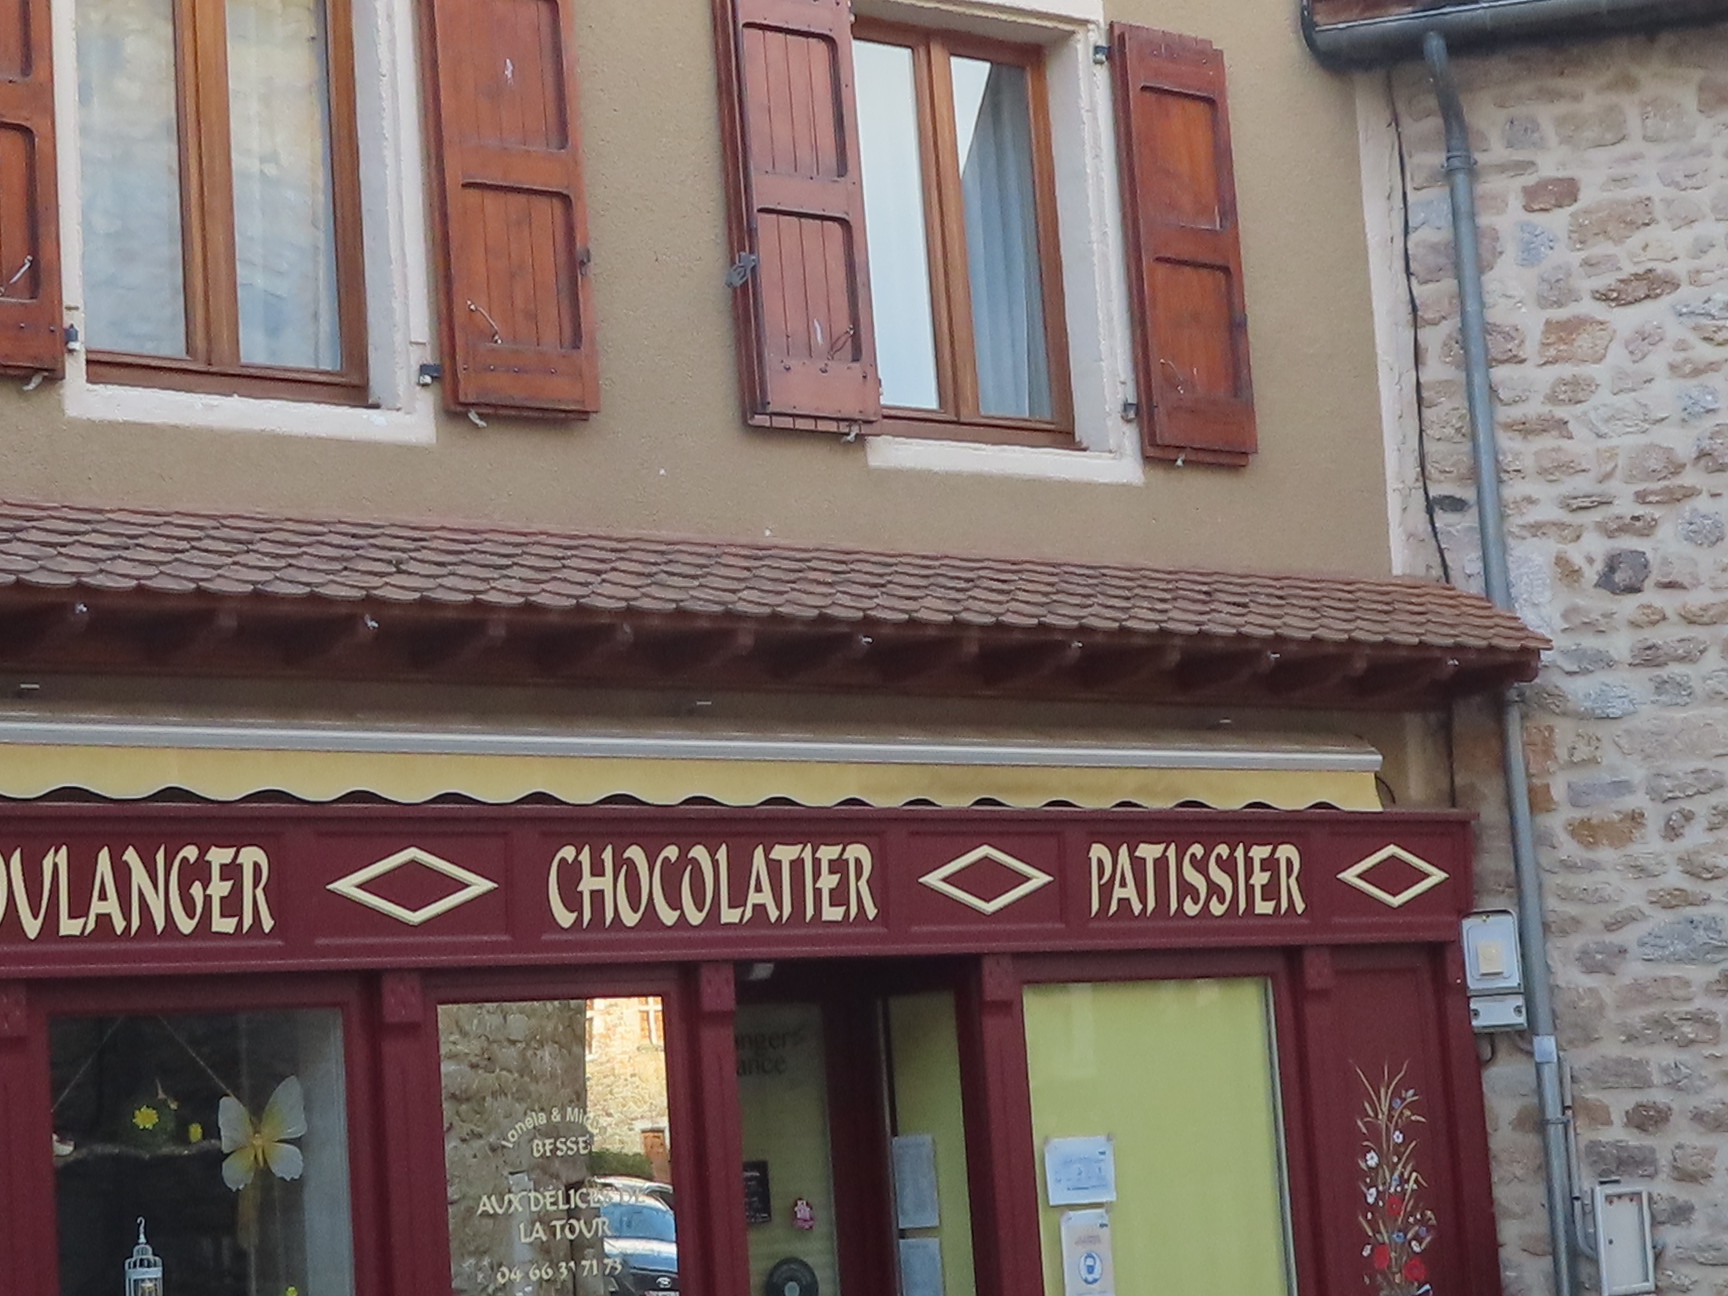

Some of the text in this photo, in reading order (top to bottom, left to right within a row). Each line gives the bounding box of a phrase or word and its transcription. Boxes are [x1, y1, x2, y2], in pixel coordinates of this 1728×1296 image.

[547, 842, 878, 930] CHOCOLATIER
[1087, 841, 1307, 918] PATISSIER
[551, 1106, 561, 1122] &
[476, 1191, 528, 1216] AUX
[519, 1217, 613, 1243] LA TOUR
[496, 1265, 524, 1284] 04
[528, 1263, 554, 1282] 66
[580, 1259, 599, 1277] 71
[602, 1257, 623, 1275] 73
